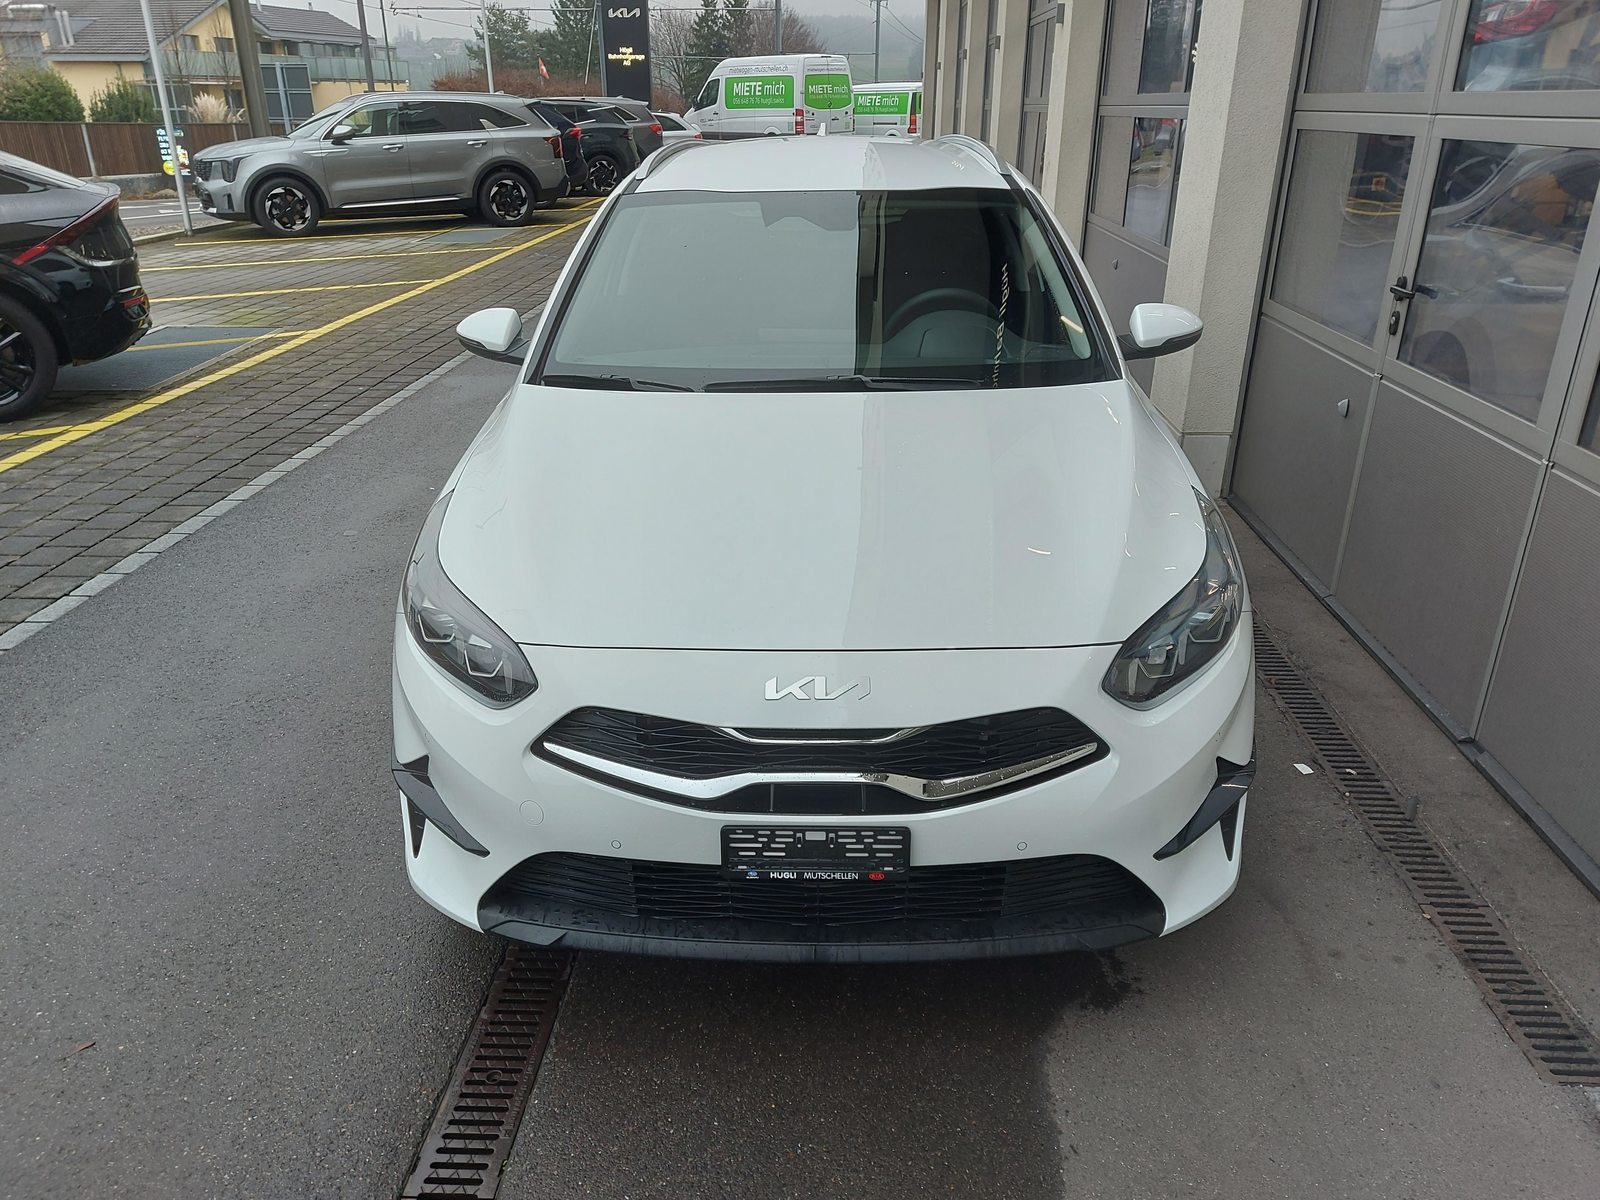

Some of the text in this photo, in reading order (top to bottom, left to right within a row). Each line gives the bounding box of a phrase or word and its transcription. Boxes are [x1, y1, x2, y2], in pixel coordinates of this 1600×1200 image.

[608, 8, 640, 18] KIA
[733, 81, 785, 96] MIETE mich
[808, 84, 848, 94] MIETE mich
[857, 95, 899, 106] MIETE mich
[765, 676, 871, 701] KIA
[803, 872, 859, 880] MUTSCHELLEN
